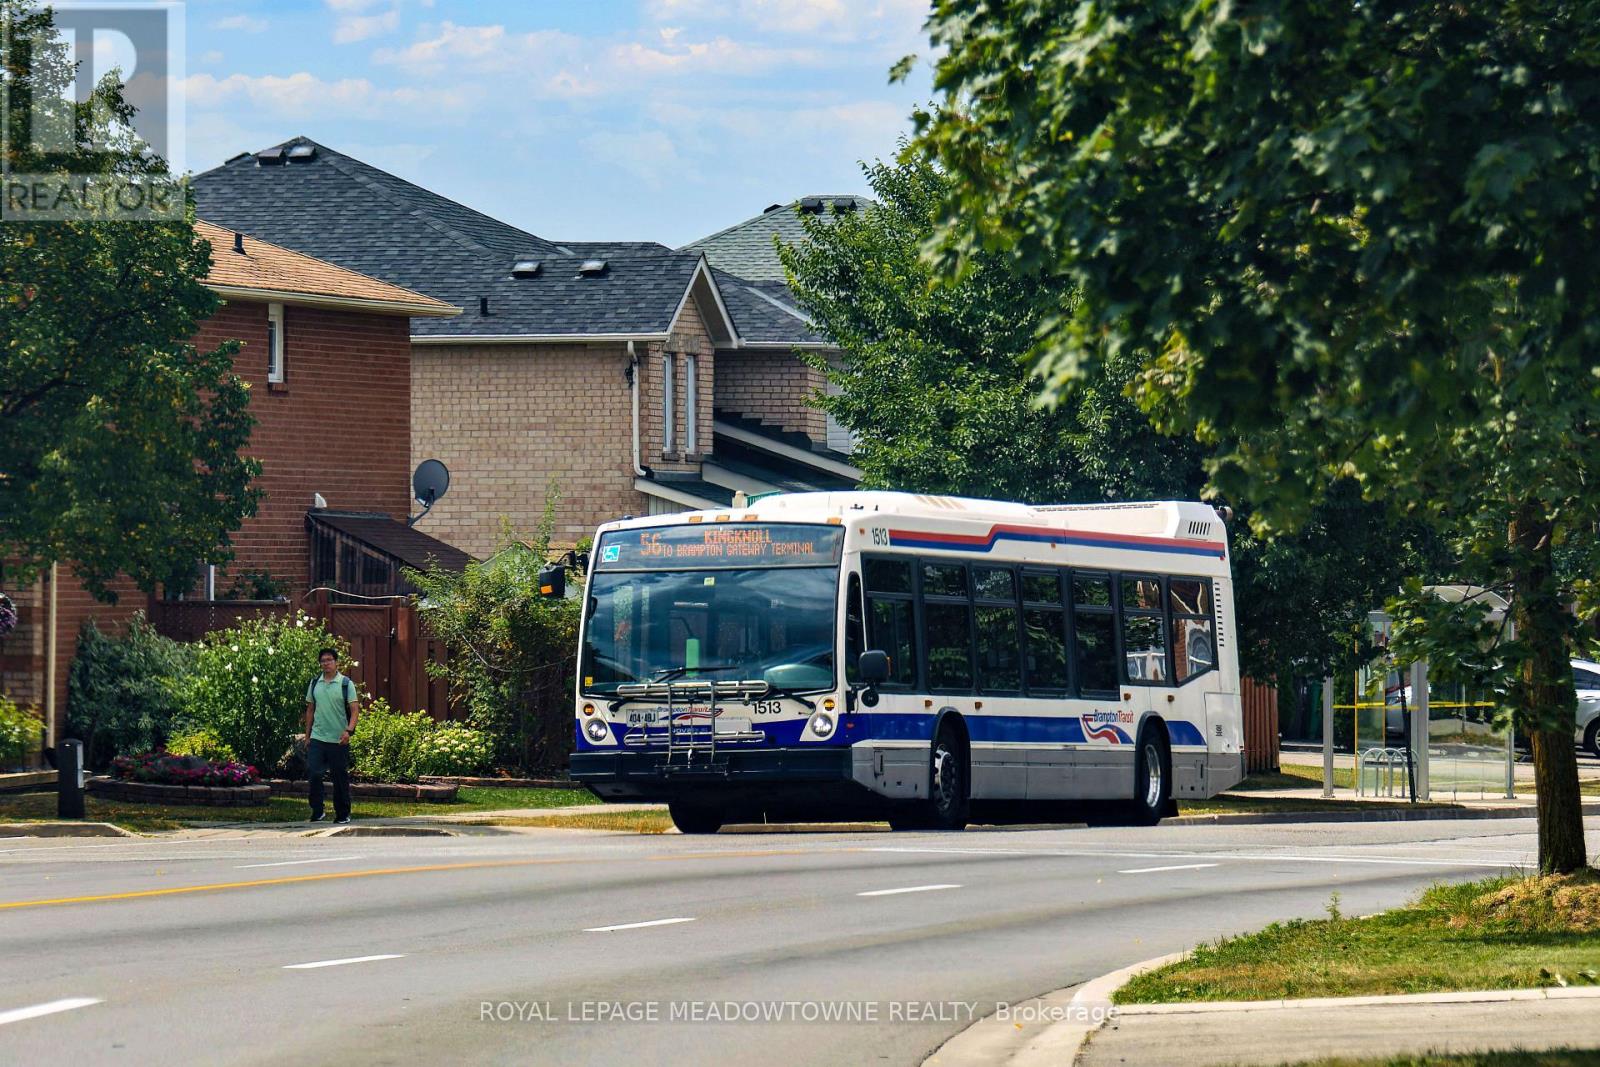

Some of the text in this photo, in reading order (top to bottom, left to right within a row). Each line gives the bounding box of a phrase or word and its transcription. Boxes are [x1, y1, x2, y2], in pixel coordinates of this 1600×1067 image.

[640, 532, 661, 555] 56
[872, 528, 888, 545] 1513
[676, 544, 722, 556] BRAMPTON
[727, 543, 767, 556] GATEWAY
[771, 542, 814, 555] TERMINAL
[752, 702, 782, 714] 1513
